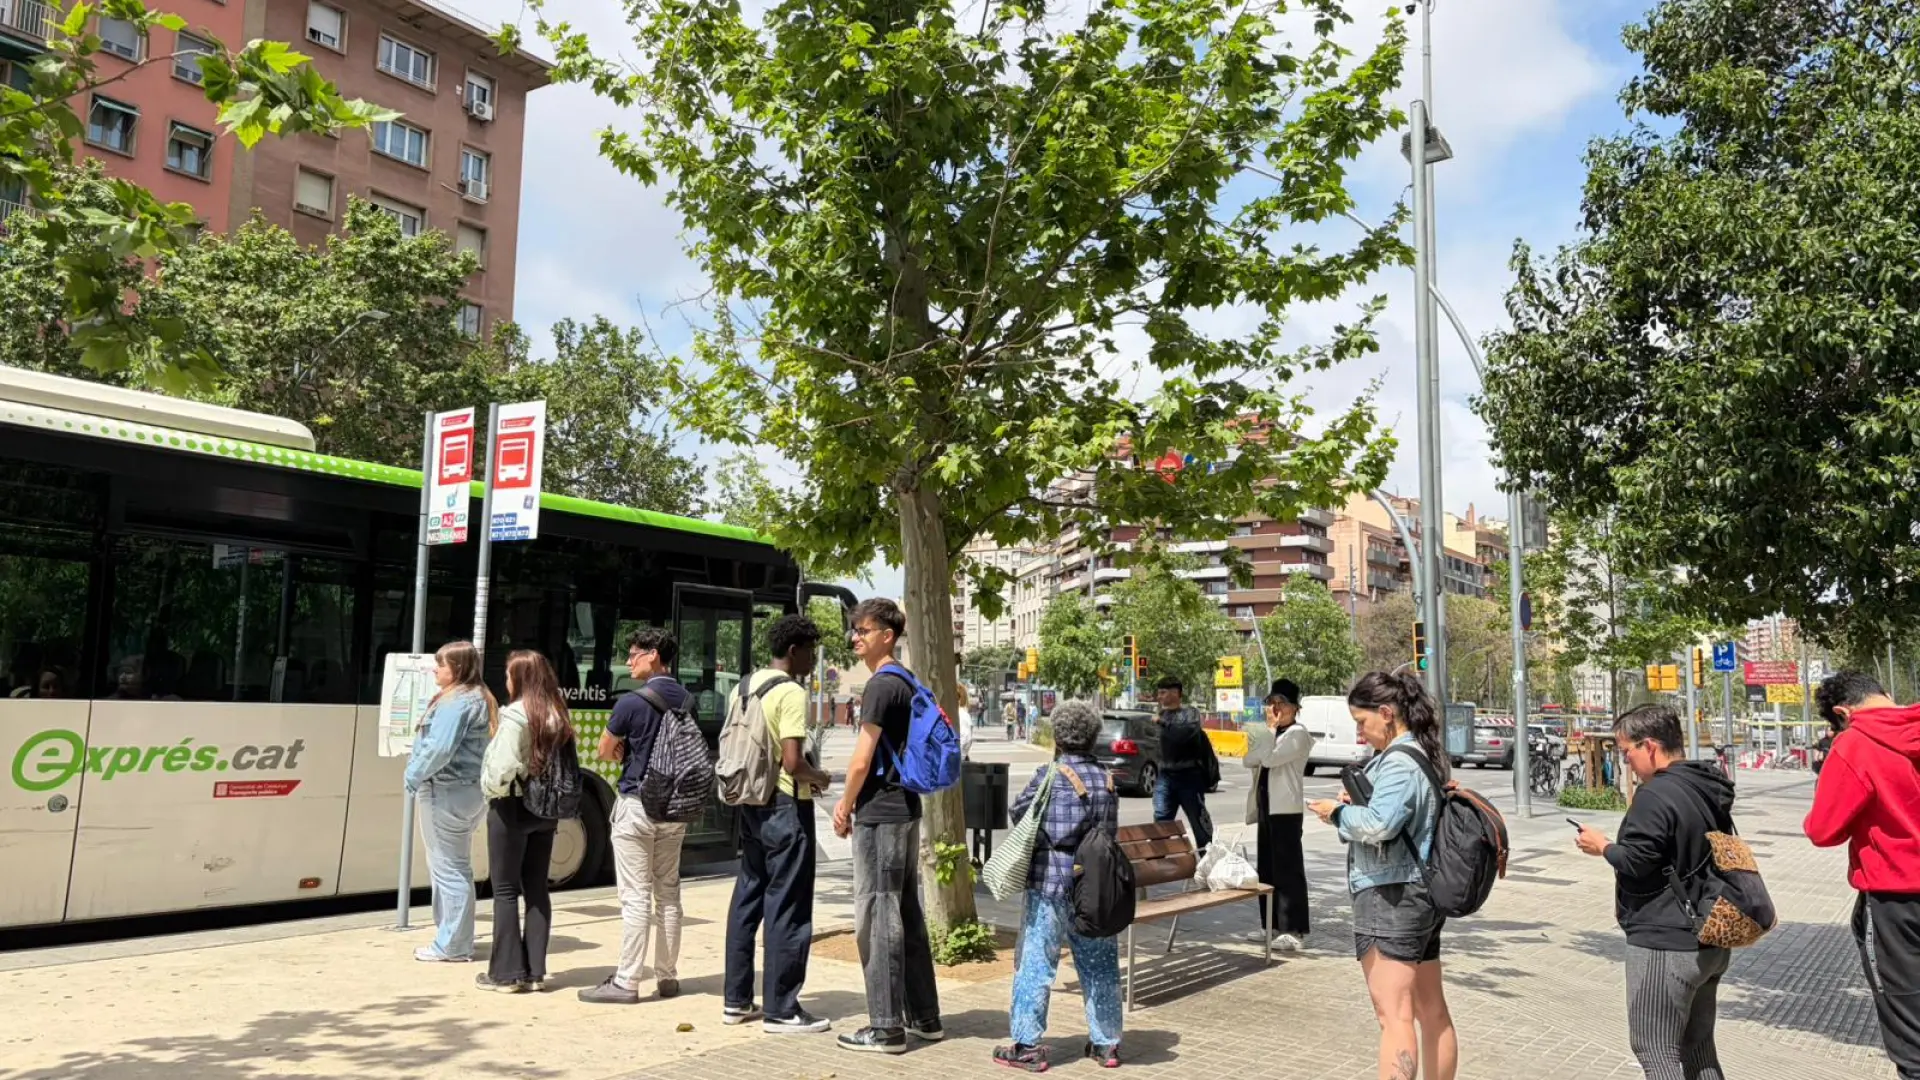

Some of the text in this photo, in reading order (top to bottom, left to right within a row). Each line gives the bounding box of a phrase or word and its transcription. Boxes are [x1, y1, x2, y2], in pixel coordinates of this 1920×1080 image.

[1718, 644, 1728, 656] P
[557, 684, 607, 701] oventis
[12, 729, 305, 791] exprés.cat
